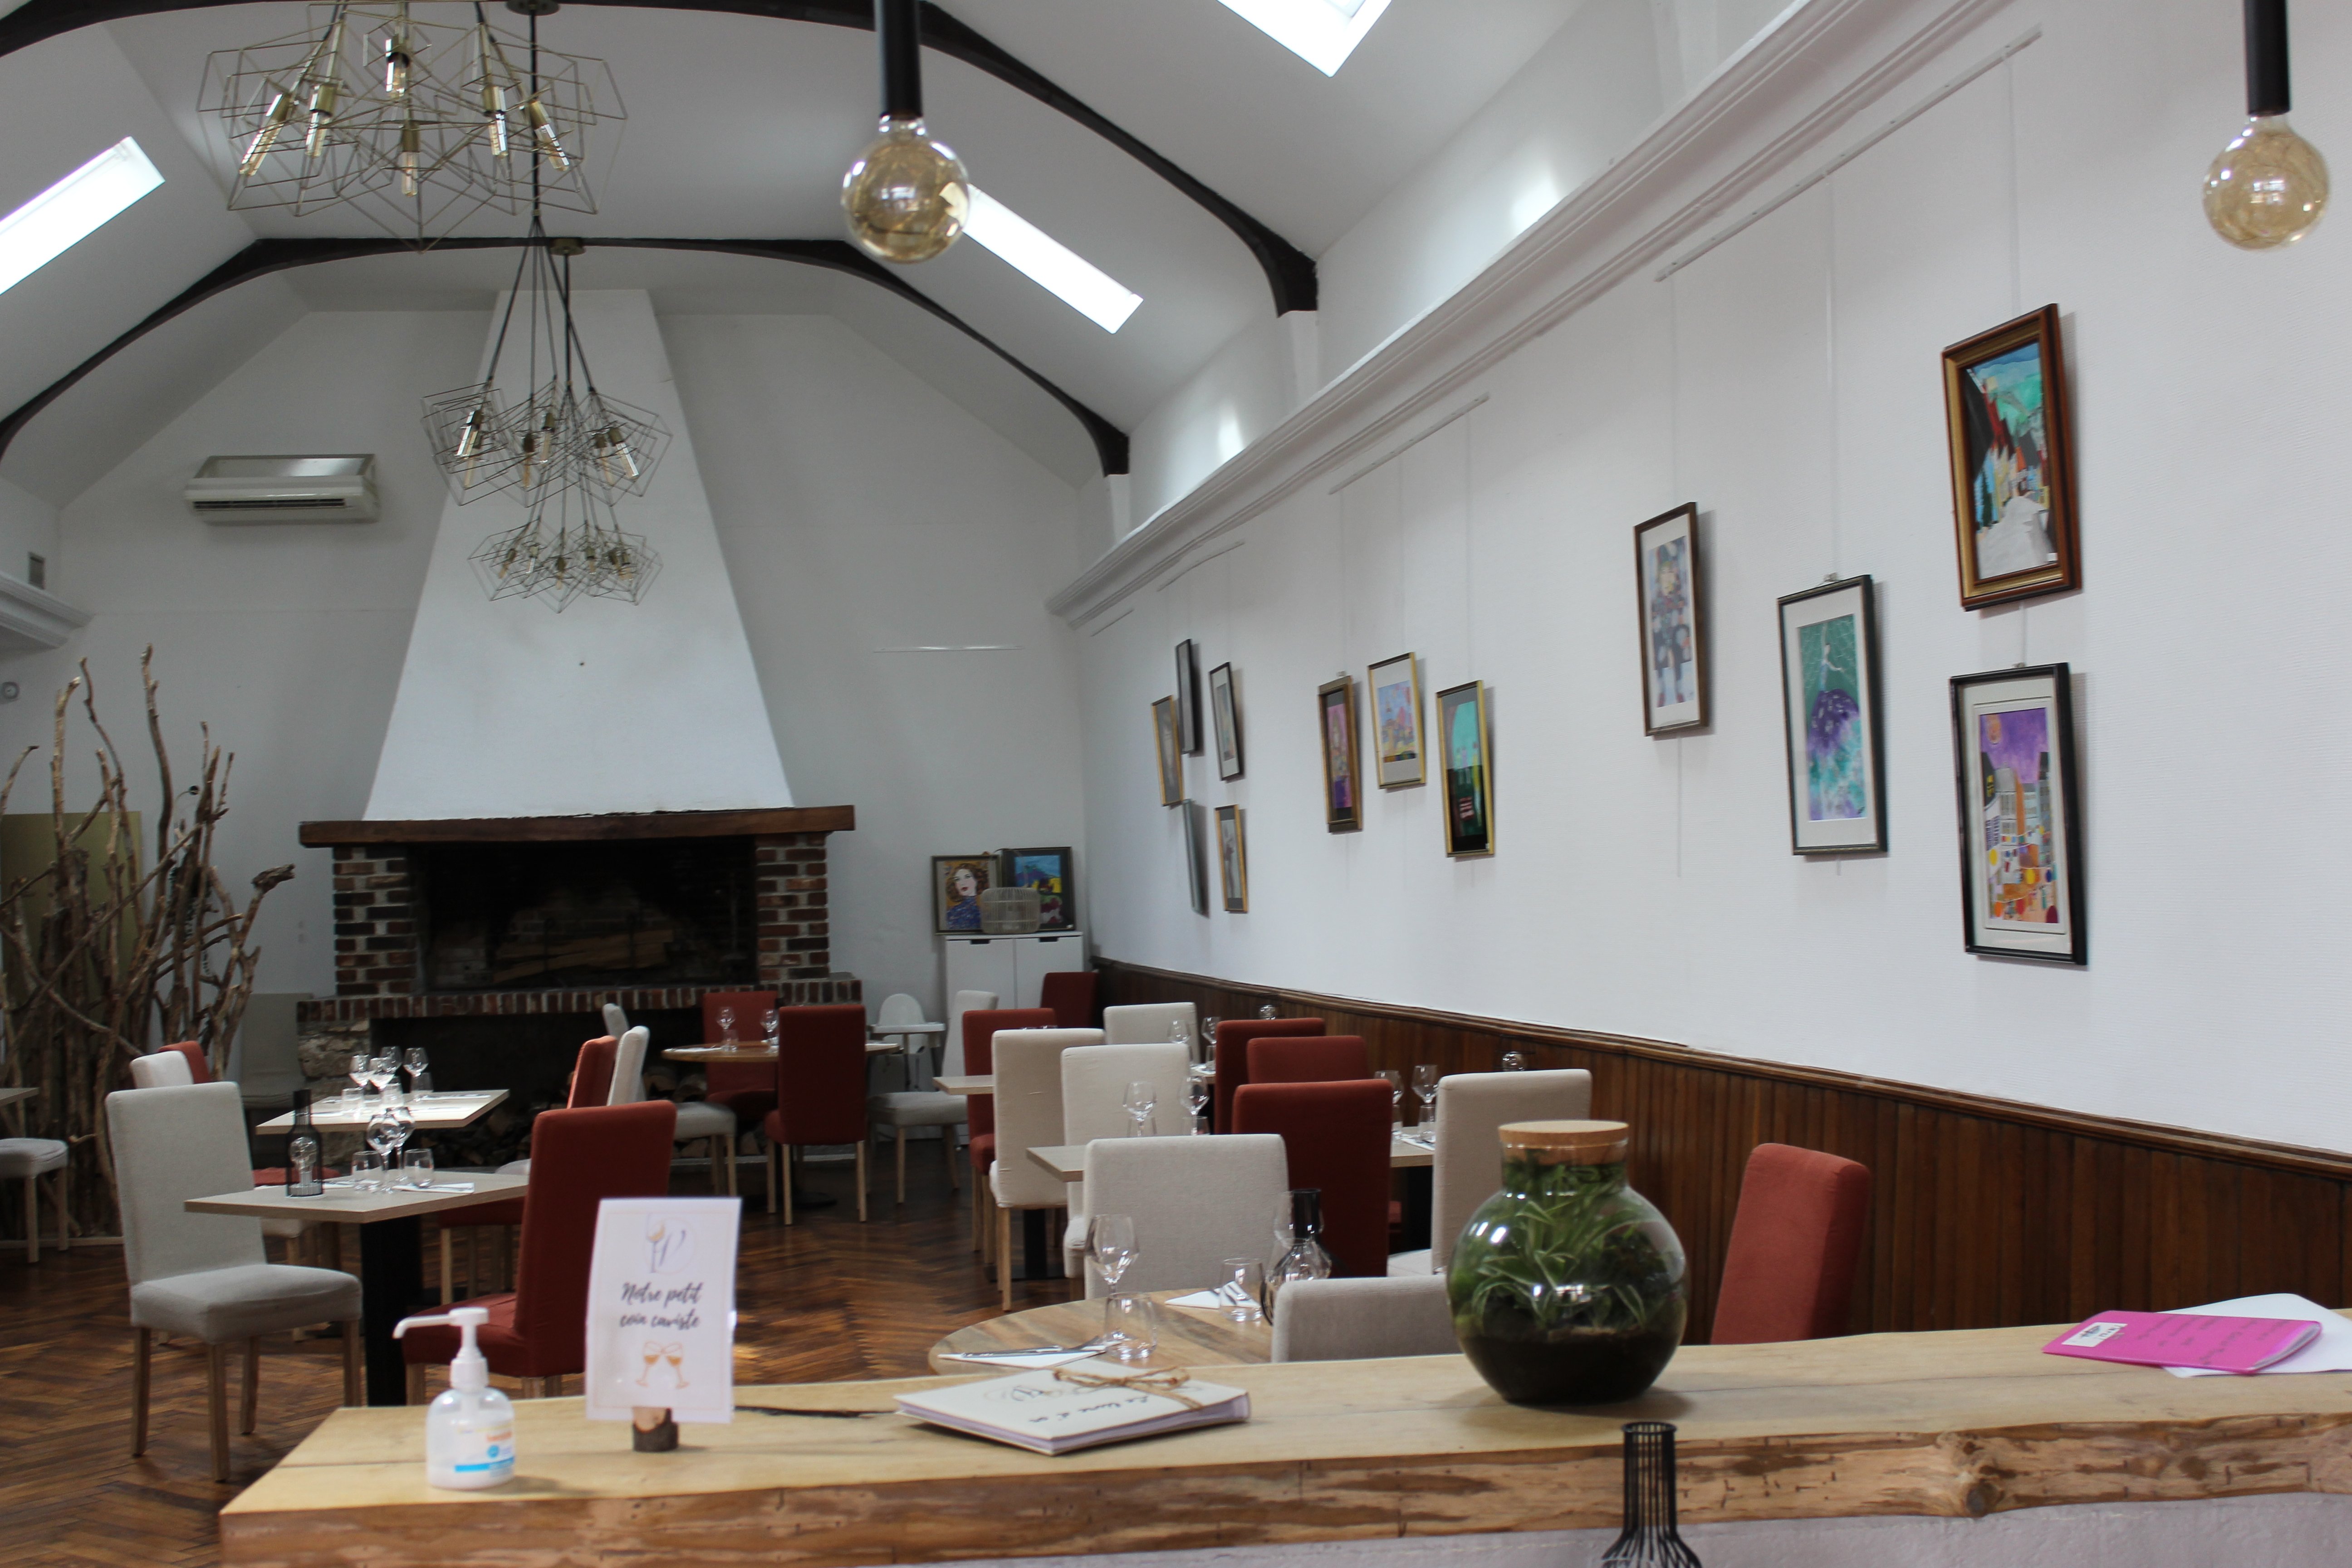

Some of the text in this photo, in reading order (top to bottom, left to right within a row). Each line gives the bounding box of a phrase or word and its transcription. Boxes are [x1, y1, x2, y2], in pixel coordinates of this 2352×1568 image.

[621, 1281, 704, 1309] Notre petit
[620, 1308, 700, 1330] coin caviste
